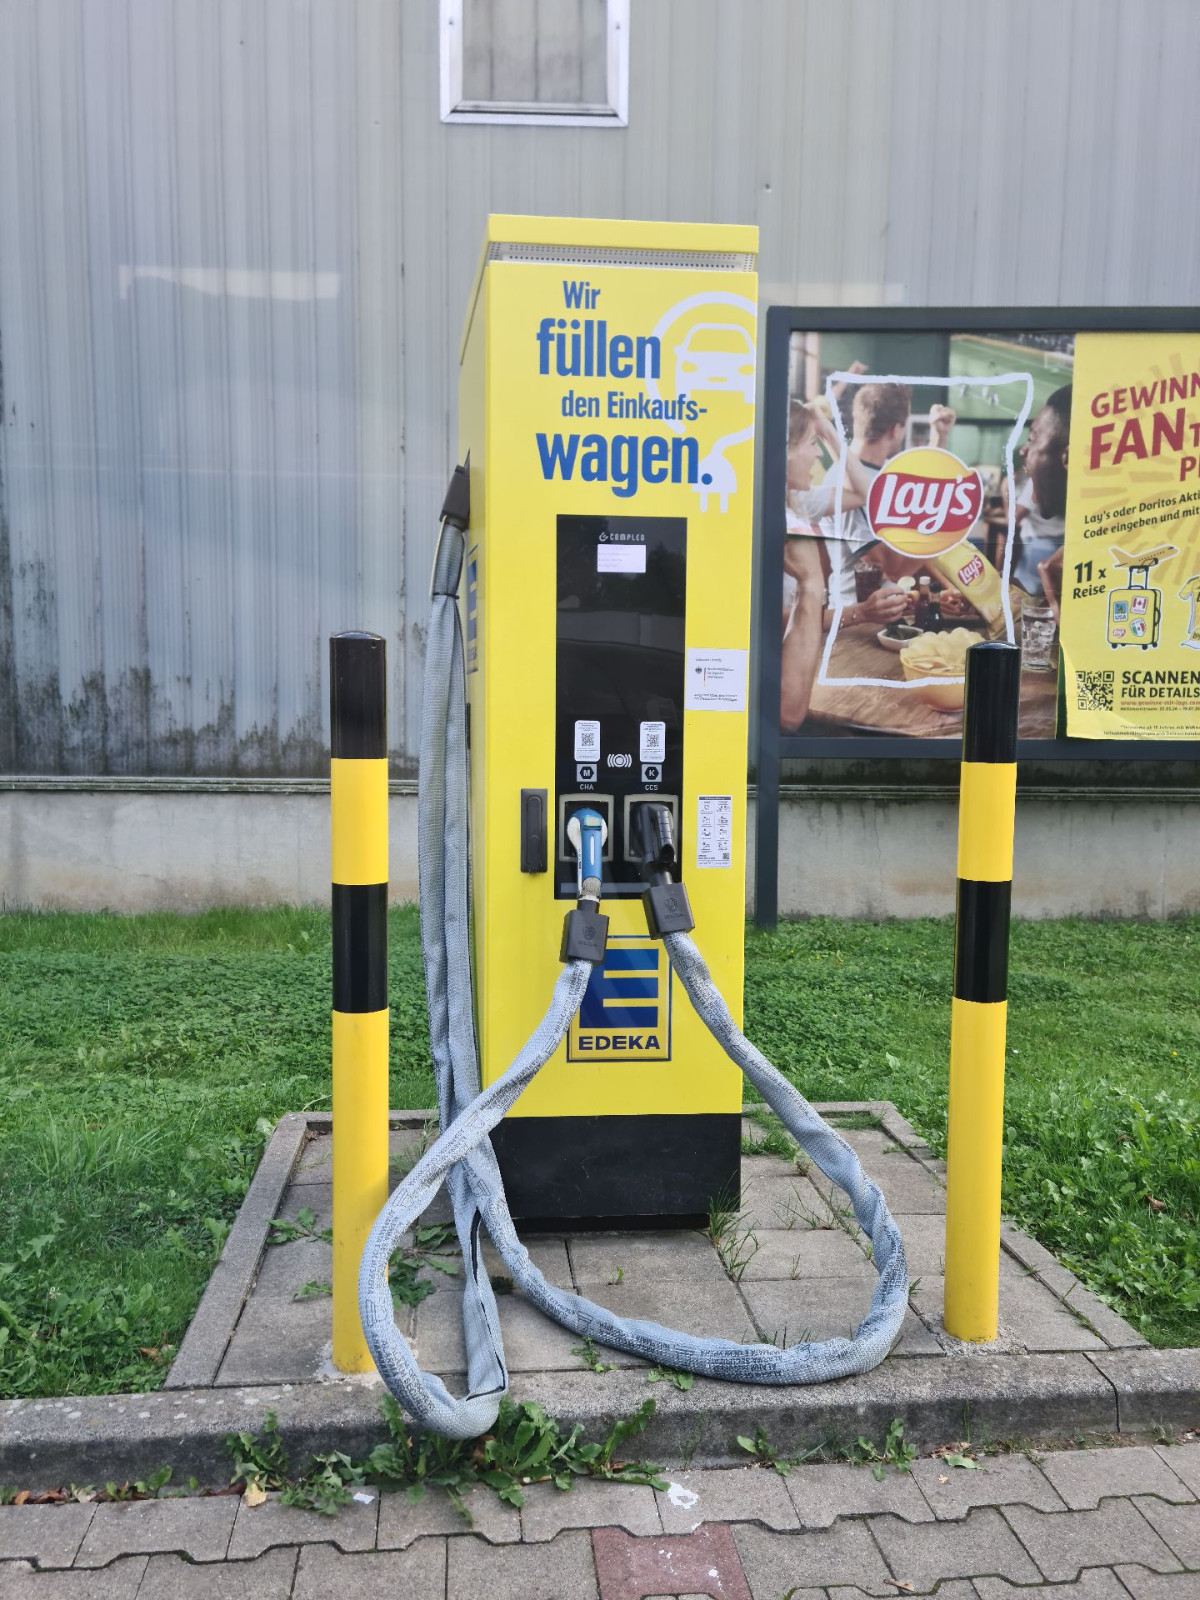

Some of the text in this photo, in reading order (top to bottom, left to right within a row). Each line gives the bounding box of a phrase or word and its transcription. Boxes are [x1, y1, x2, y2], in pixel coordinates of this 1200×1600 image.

[562, 280, 601, 310] Wir
[536, 317, 661, 379] füllen
[561, 389, 708, 421] den Einkaufs-
[535, 432, 713, 499] wagen.
[874, 474, 976, 535] Lay's
[1084, 511, 1111, 525] Lay's
[1112, 505, 1137, 519] oder
[1139, 496, 1178, 514] Doritos
[1083, 505, 1200, 540] Code eingeben und mit
[1074, 560, 1093, 584] 11
[1072, 582, 1107, 600] Reise
[1121, 684, 1200, 698] FÜR DETAILS
[1122, 670, 1200, 685] SCANNEN
[578, 1036, 661, 1051] EDEKA
